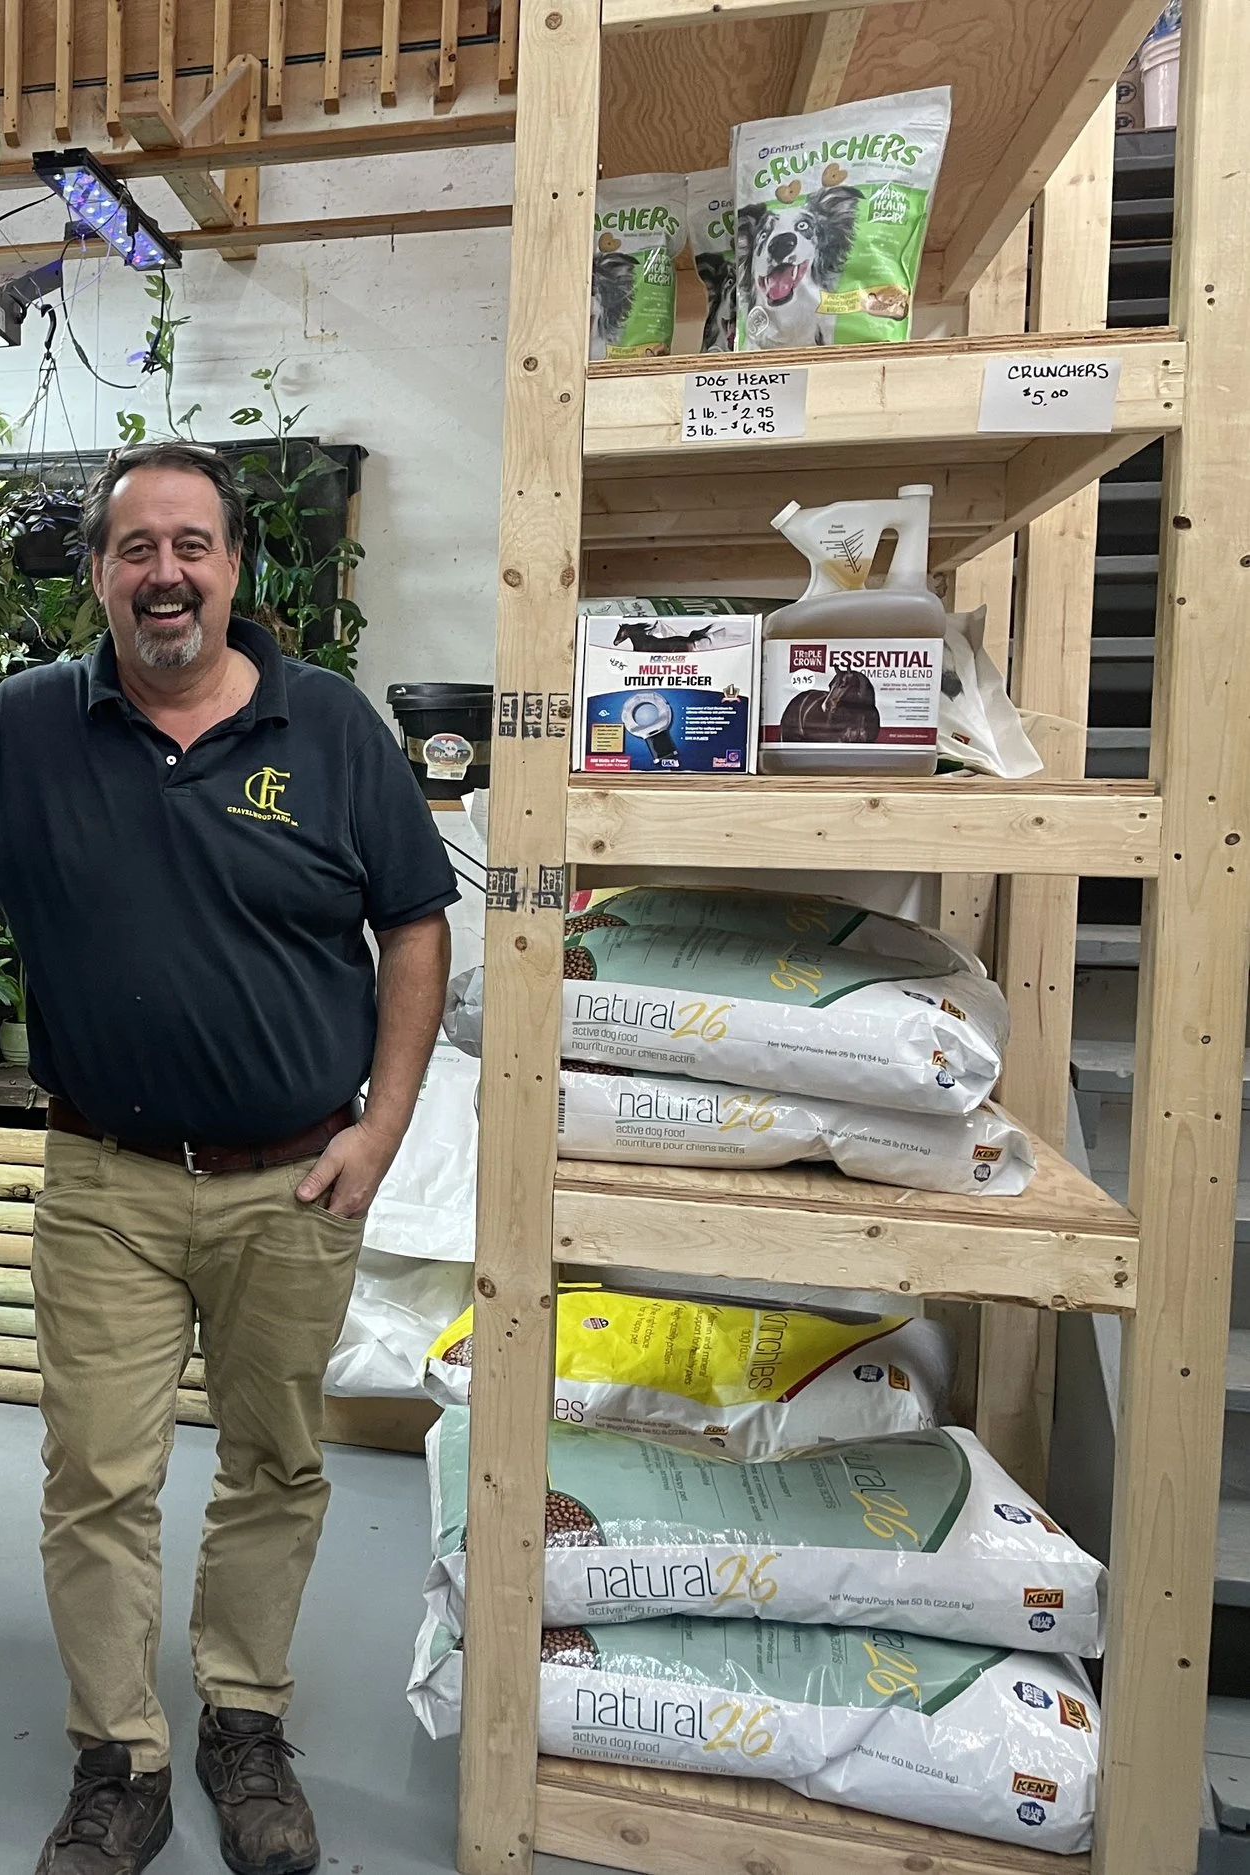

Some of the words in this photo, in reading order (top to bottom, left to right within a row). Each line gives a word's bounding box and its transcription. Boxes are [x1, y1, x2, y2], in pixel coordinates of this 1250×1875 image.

[753, 132, 923, 189] CRUNCHERS
[1007, 363, 1109, 380] CRUNCHERS
[695, 375, 728, 387] DOG
[738, 372, 790, 386] HEART
[710, 388, 770, 402] TREATS
[1022, 387, 1069, 407] $5.00
[688, 408, 696, 420] 1
[686, 425, 697, 437] 3
[793, 657, 823, 667] CROWN
[829, 650, 933, 669] ESSENTIAL
[638, 664, 699, 676] MULTI-USE
[861, 669, 897, 679] OMEGA
[899, 669, 933, 679] BLEND
[624, 676, 665, 687] UTILITY
[667, 675, 712, 687] DE-ICER
[792, 675, 814, 686] 29.95
[227, 806, 271, 820] GRAVELWOOD
[272, 814, 291, 824] FARM
[576, 993, 676, 1031] natural
[670, 1001, 732, 1043] 26
[572, 1026, 599, 1038] active
[601, 1029, 616, 1043] dog
[617, 1031, 638, 1043] food
[615, 1046, 636, 1058] pour
[637, 1047, 669, 1061] chiens
[618, 1090, 723, 1125] natural
[718, 1094, 778, 1133] 26
[616, 1125, 644, 1136] active
[645, 1127, 663, 1138] dog
[664, 1128, 685, 1138] food
[616, 1138, 661, 1149] nourriture
[662, 1142, 684, 1152] pour
[881, 1138, 891, 1146] 25
[975, 1149, 1001, 1161] KENT
[631, 1317, 645, 1334] happy
[630, 1334, 640, 1345] pet
[642, 1329, 655, 1349] choice
[662, 1341, 676, 1365] protein
[698, 1350, 713, 1377] mineral
[850, 1492, 919, 1542] 26
[586, 1557, 719, 1600] natural
[714, 1554, 779, 1605] 26
[911, 1598, 922, 1606] 50
[924, 1599, 931, 1607] lb
[961, 1600, 974, 1611] kg)
[1027, 1591, 1061, 1605] KENT
[647, 1605, 673, 1615] food
[863, 1641, 921, 1700] 26
[576, 1687, 708, 1742] natural
[702, 1700, 774, 1758] 26
[572, 1732, 607, 1745] active
[609, 1737, 632, 1752] dog
[633, 1741, 660, 1753] food
[875, 1751, 889, 1762] Net
[891, 1756, 903, 1767] 50
[905, 1759, 914, 1770] lb
[945, 1772, 959, 1784] kg)
[1017, 1781, 1055, 1796] KENT
[1022, 1804, 1043, 1816] BLUE
[1020, 1813, 1042, 1824] SEAL
